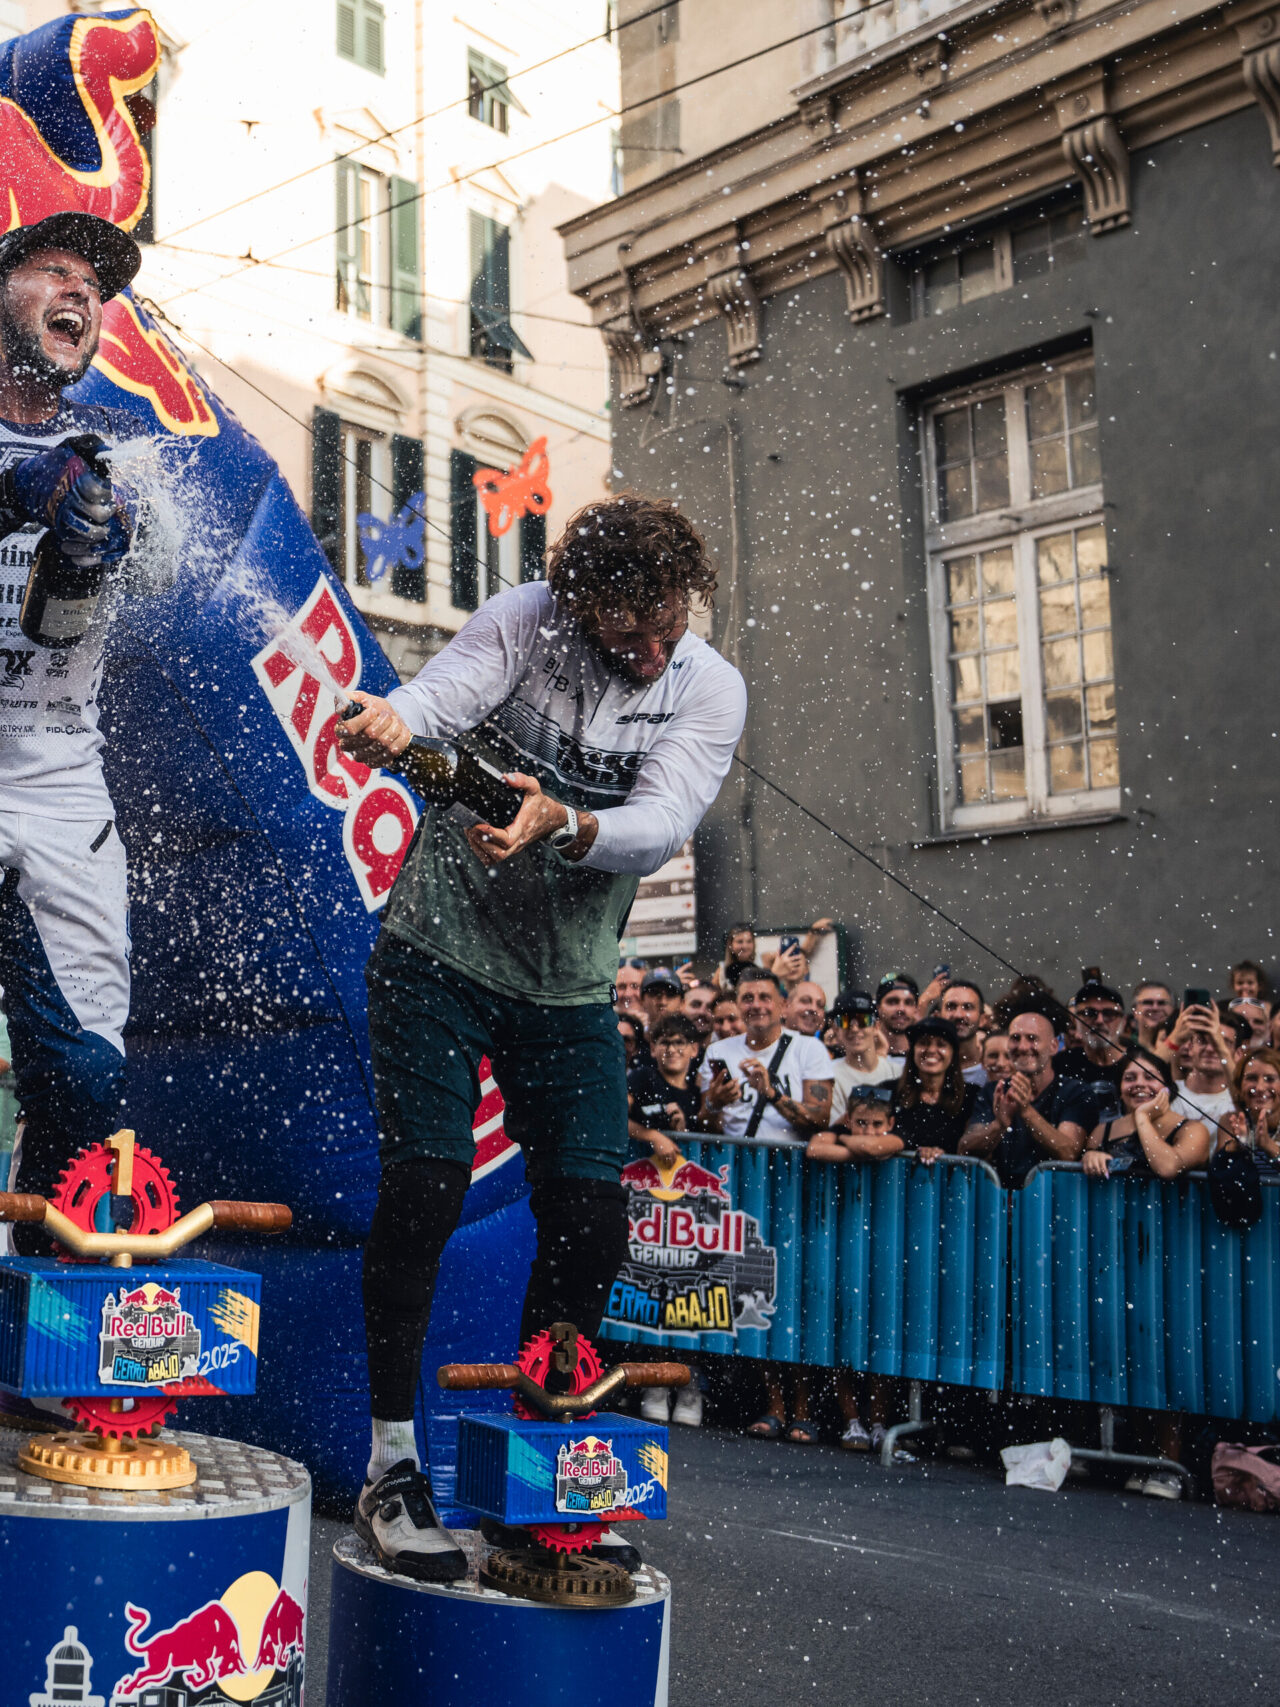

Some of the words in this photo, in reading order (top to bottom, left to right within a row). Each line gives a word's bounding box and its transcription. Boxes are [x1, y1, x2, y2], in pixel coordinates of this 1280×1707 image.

[104, 1128, 135, 1196] 1
[669, 1209, 743, 1253] Bull
[605, 1281, 660, 1325] ERRO
[665, 1286, 730, 1329] ABAJO
[111, 1315, 148, 1337] Red
[151, 1315, 186, 1336] Bull
[199, 1342, 244, 1375] 2025
[549, 1322, 579, 1374] 3
[114, 1356, 146, 1382] CERRO
[148, 1354, 179, 1382] ABAJO
[564, 1460, 589, 1477] Red
[591, 1459, 616, 1476] Bull
[590, 1489, 612, 1510] ABAJO
[626, 1479, 657, 1508] 2025
